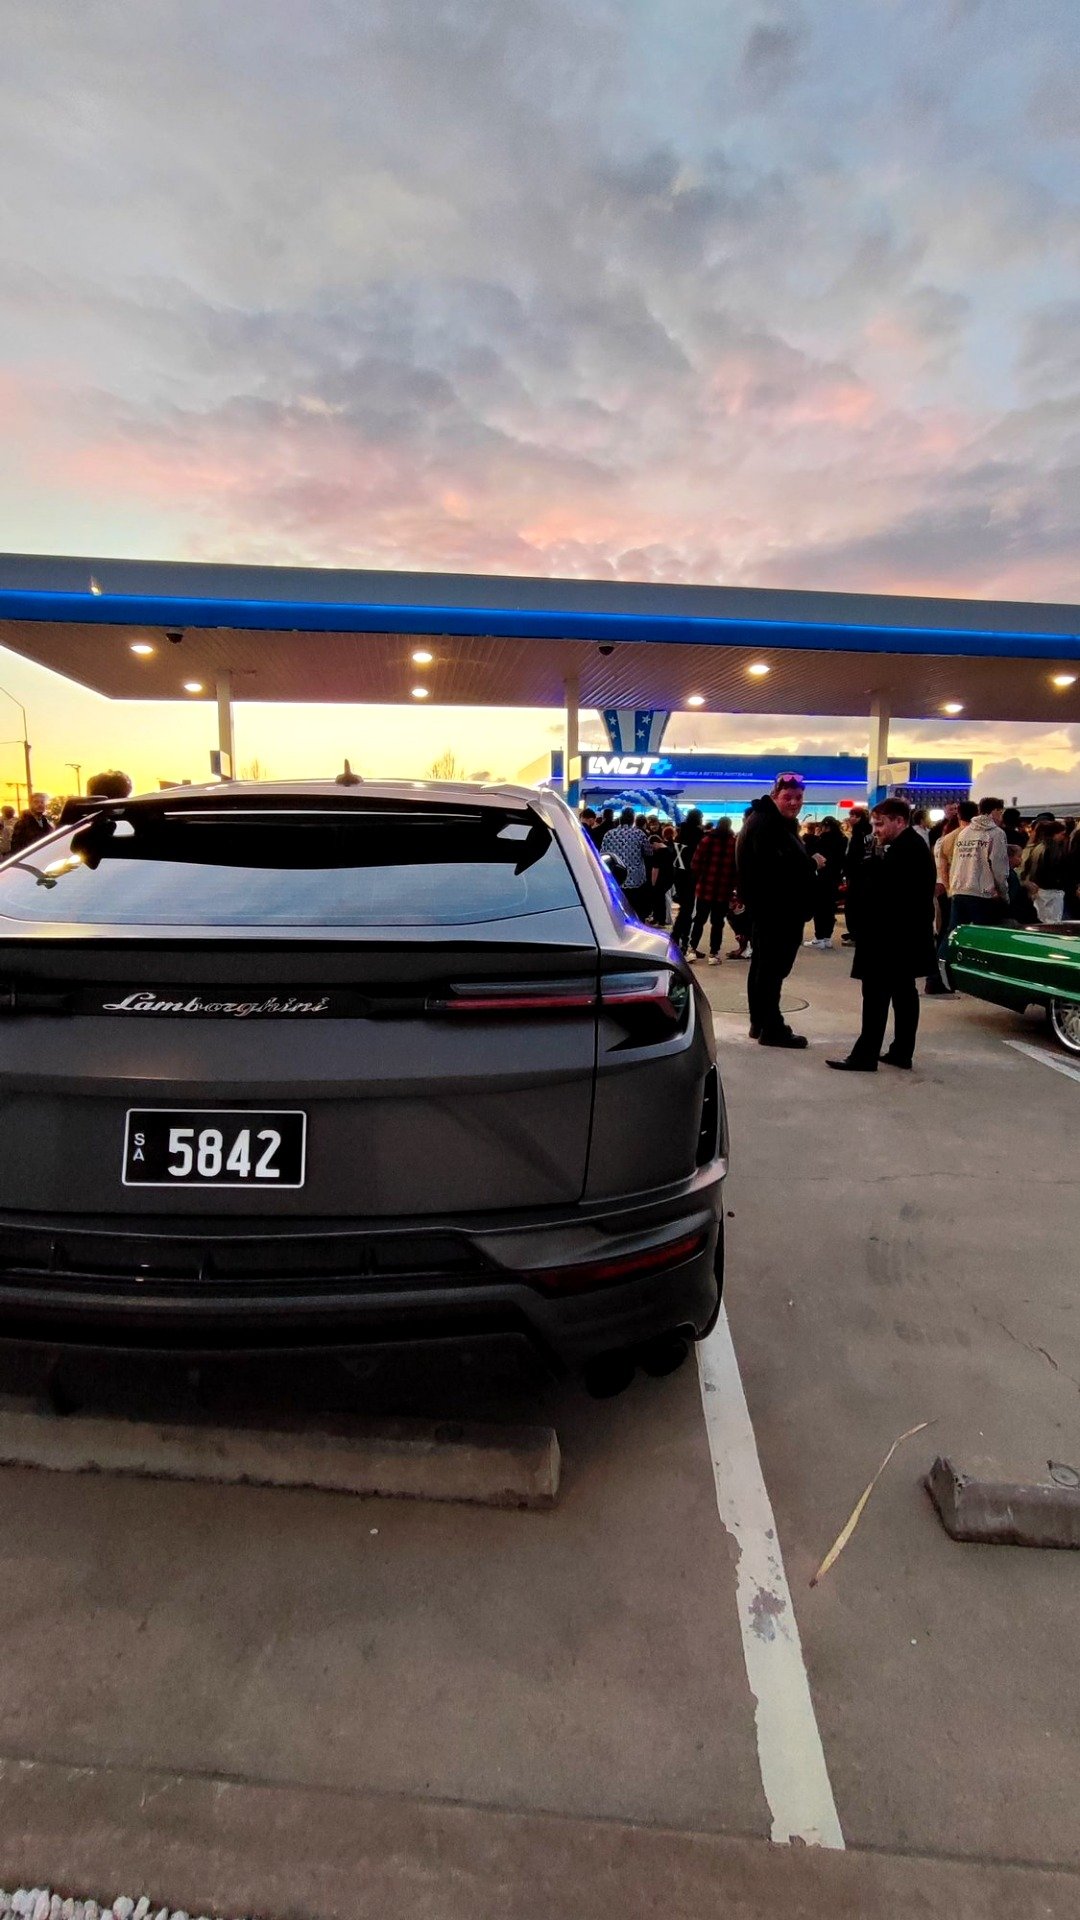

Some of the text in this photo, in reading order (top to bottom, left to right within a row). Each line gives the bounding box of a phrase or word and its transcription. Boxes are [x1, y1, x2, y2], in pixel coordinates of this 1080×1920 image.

[673, 842, 688, 870] X
[102, 991, 329, 1017] Lamborghini
[167, 1128, 282, 1178] 5842
